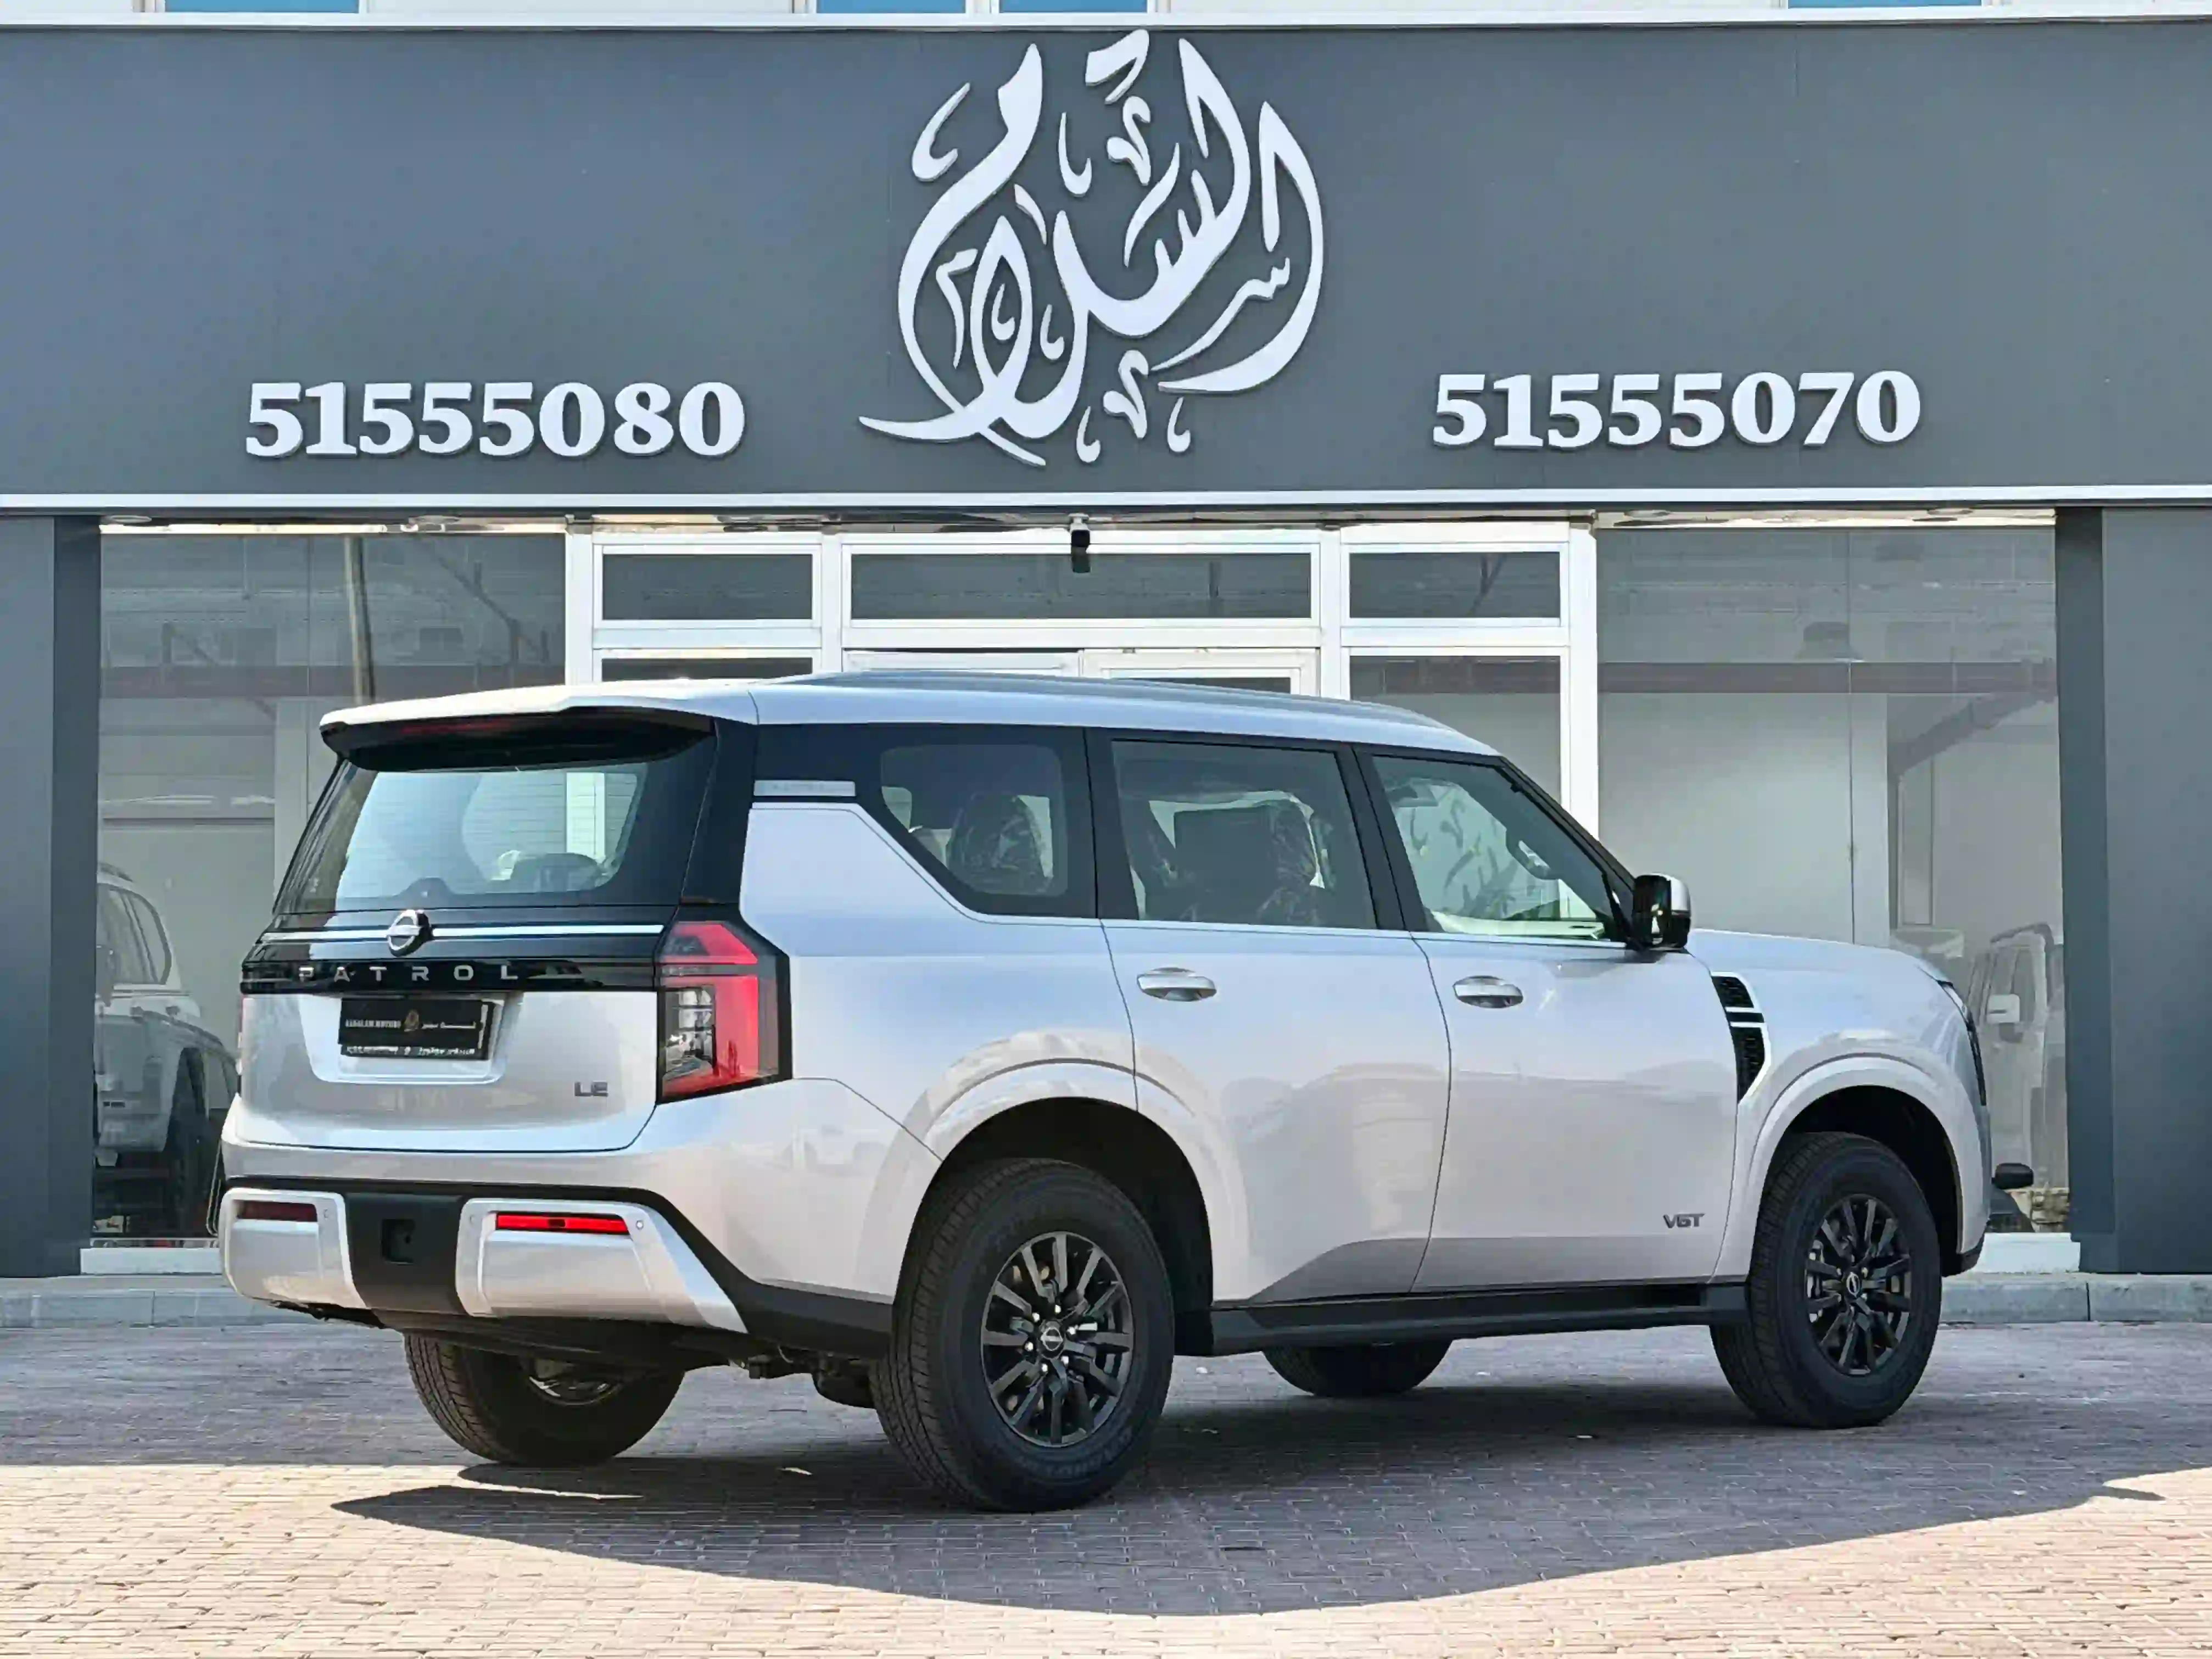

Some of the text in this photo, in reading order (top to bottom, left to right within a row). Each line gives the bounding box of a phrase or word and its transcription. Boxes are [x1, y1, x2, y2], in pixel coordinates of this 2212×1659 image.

[245, 382, 746, 457] 51555080
[1432, 370, 1921, 451] 51555070
[298, 965, 519, 982] PATROL
[574, 1081, 608, 1097] LE
